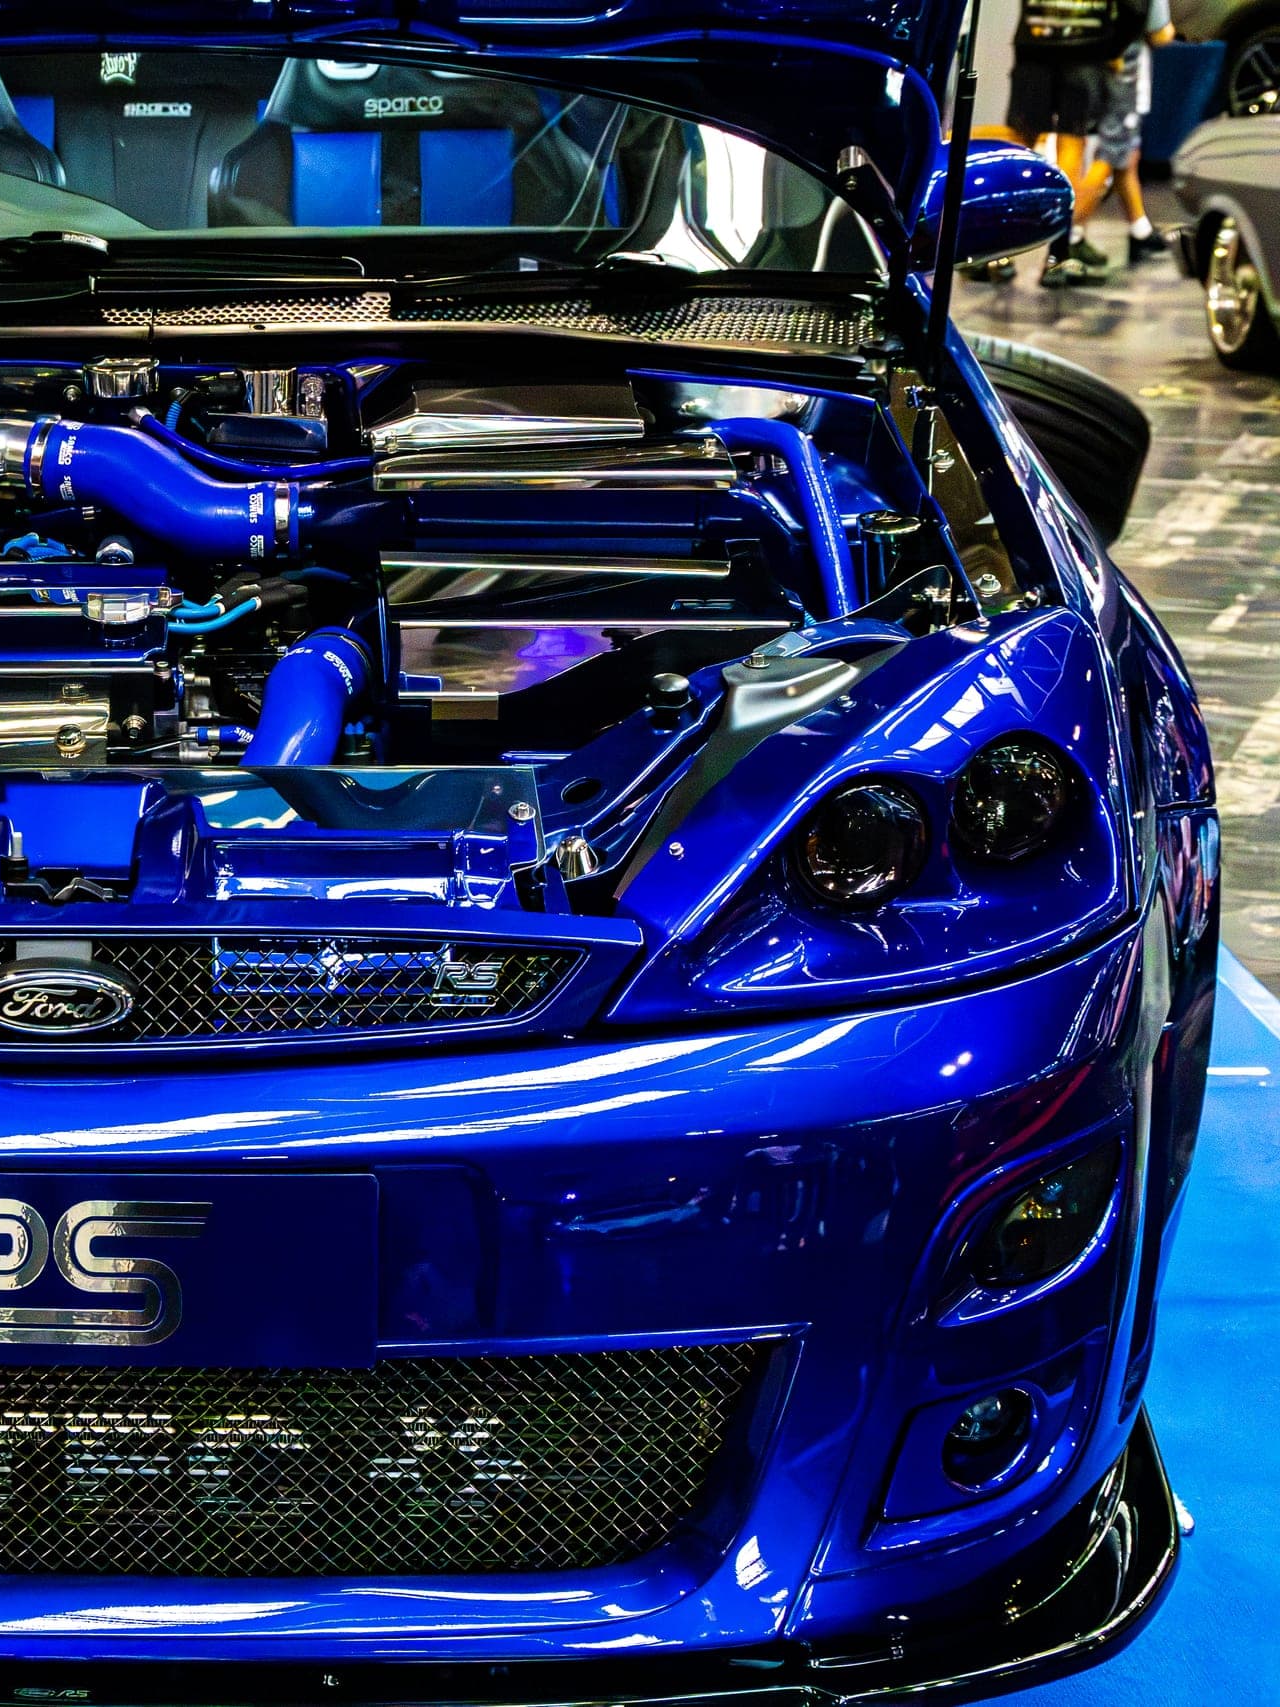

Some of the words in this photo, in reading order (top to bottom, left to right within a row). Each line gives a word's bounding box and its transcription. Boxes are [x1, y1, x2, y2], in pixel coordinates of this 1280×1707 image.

[364, 95, 444, 118] sparco
[249, 493, 258, 524] SAMCO
[234, 727, 255, 743] SAM
[433, 962, 503, 989] RS
[2, 987, 104, 1019] Ford
